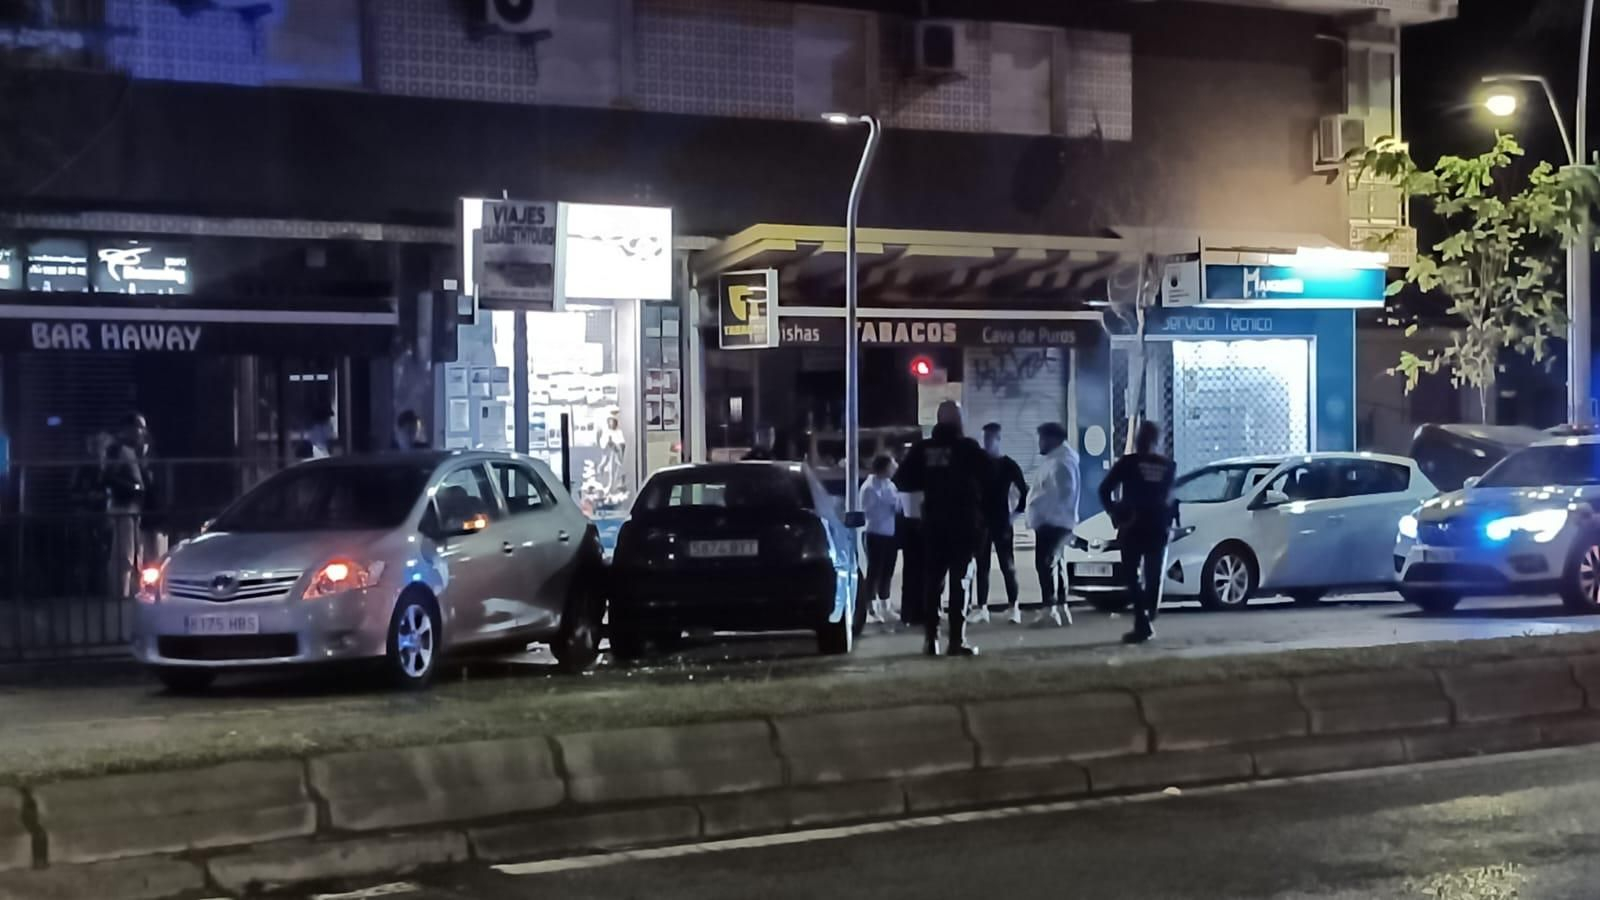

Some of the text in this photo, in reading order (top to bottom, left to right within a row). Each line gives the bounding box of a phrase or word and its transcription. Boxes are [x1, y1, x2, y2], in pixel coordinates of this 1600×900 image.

[493, 206, 545, 224] VIAJES
[31, 322, 201, 351] BAR HAWAY
[982, 327, 1076, 344] Cava de Puros
